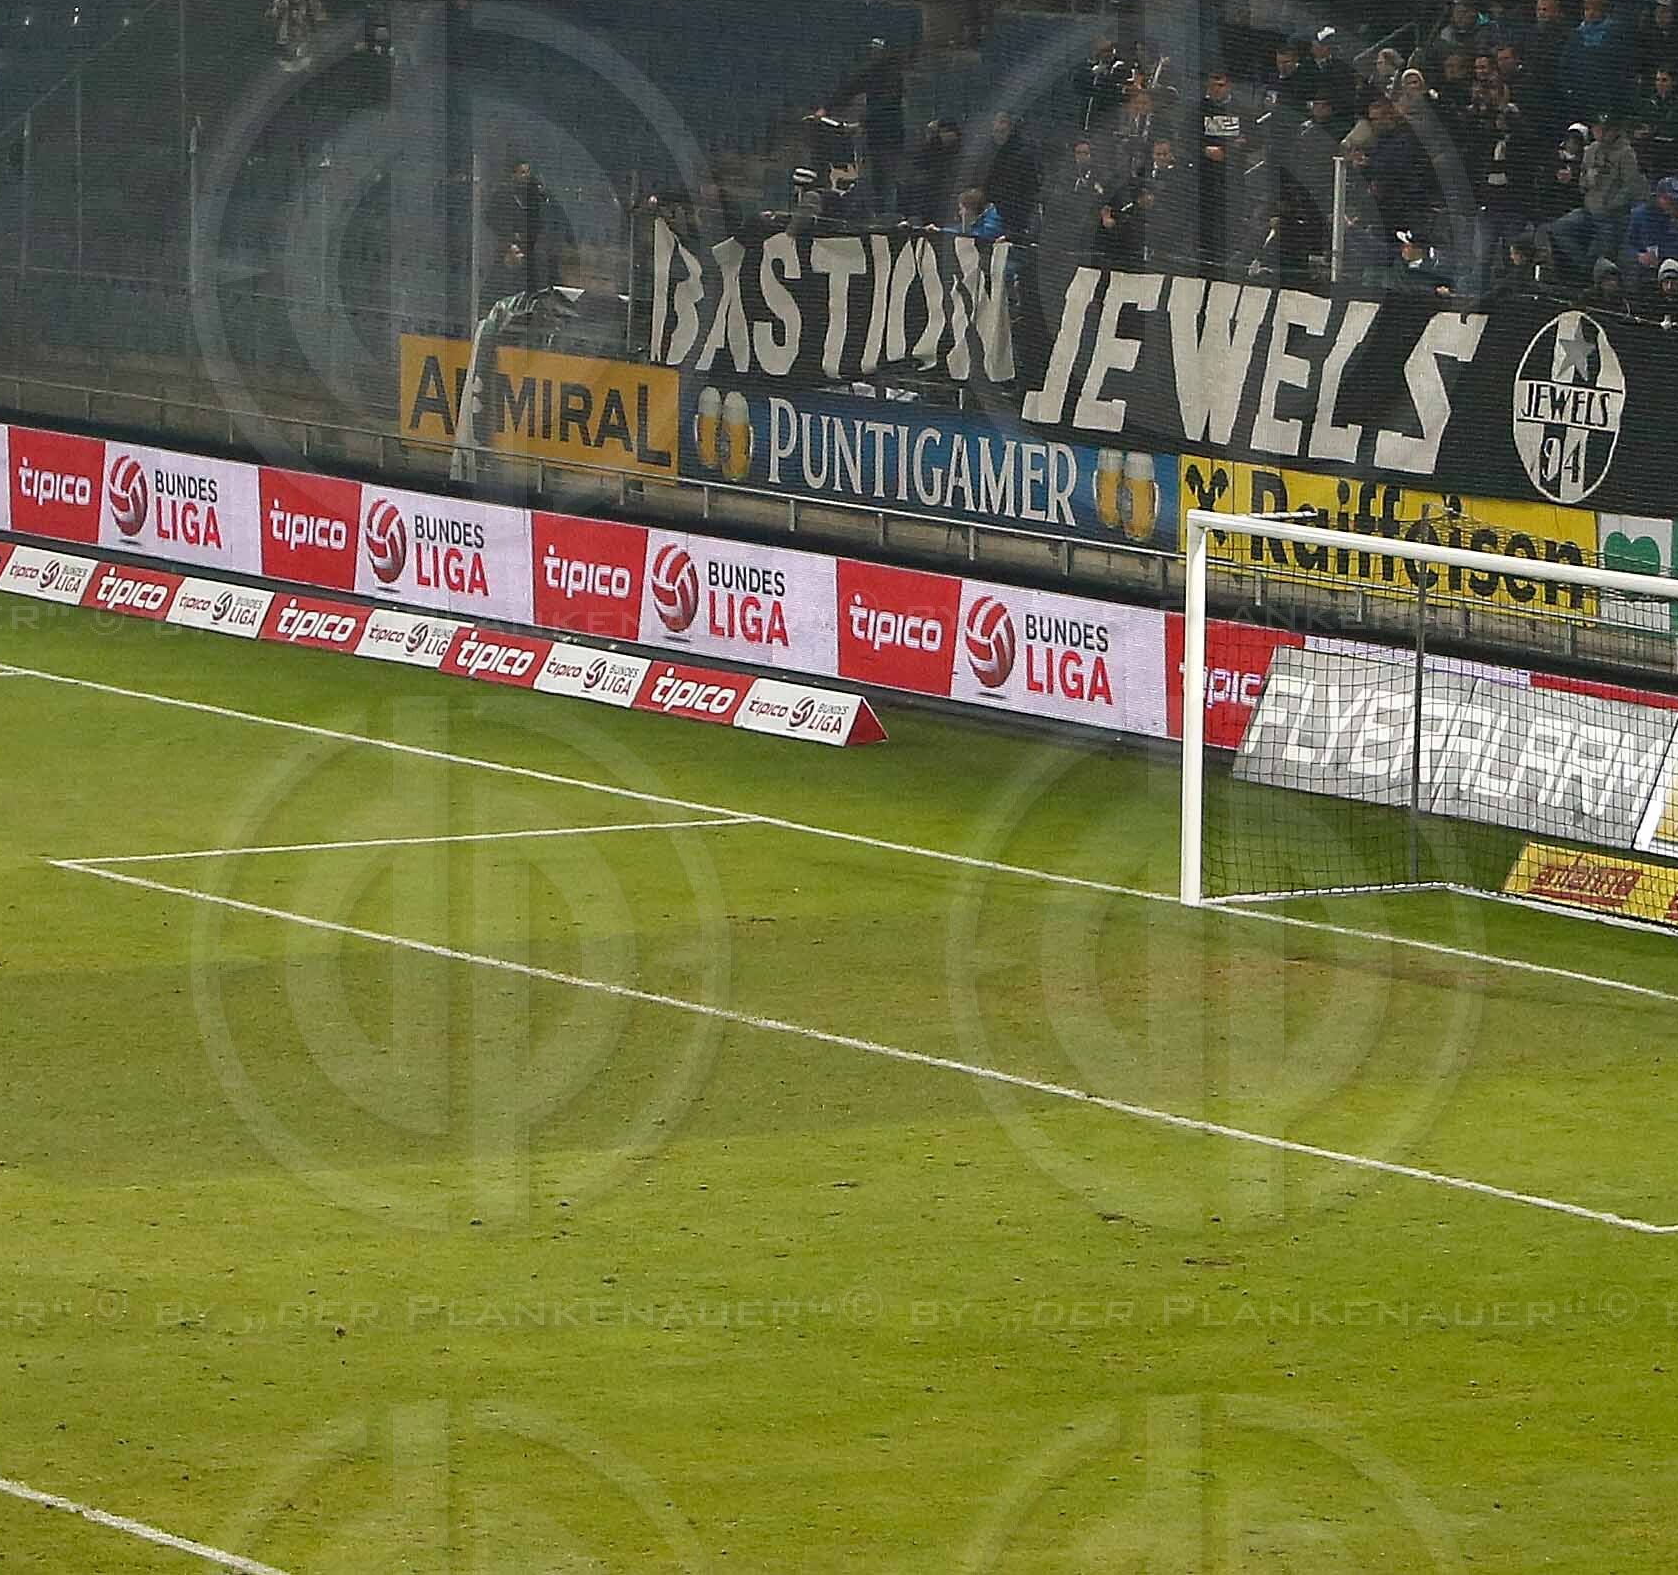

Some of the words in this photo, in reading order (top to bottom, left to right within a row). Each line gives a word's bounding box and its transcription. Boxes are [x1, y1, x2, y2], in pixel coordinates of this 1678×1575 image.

[651, 218, 1016, 382] BASTION
[1022, 266, 1489, 475] JEWELS
[409, 355, 672, 467] AMIRAL
[1521, 381, 1611, 427] JEWELS
[18, 457, 91, 505] tipico
[768, 398, 1078, 527] PUNTIGAMER
[1539, 435, 1581, 484] 94
[155, 470, 218, 503] BUNDES
[156, 497, 222, 549] LIGA
[271, 498, 347, 551] tipico
[414, 515, 485, 548] BUNDES
[1250, 470, 1586, 609] Raiffeisen
[96, 567, 168, 610] tipico
[416, 542, 490, 597] LIGA
[543, 544, 631, 600] tipico
[708, 561, 785, 598] BUNDES
[227, 606, 258, 627] LIGA
[277, 598, 356, 642] tipico
[368, 625, 404, 644] tipico
[709, 591, 790, 648] LIGA
[849, 593, 942, 652] tipico
[1025, 613, 1109, 652] BUNDES
[425, 637, 452, 657] LIG
[456, 631, 536, 676] tipico
[546, 657, 582, 679] tipico
[601, 676, 633, 697] LIGA
[651, 667, 737, 714] tipico
[1026, 645, 1113, 706] LIGA
[1178, 663, 1264, 708] pic
[748, 696, 789, 719] tipico
[808, 714, 843, 735] LIGA
[1239, 672, 1665, 822] FLYERALARM
